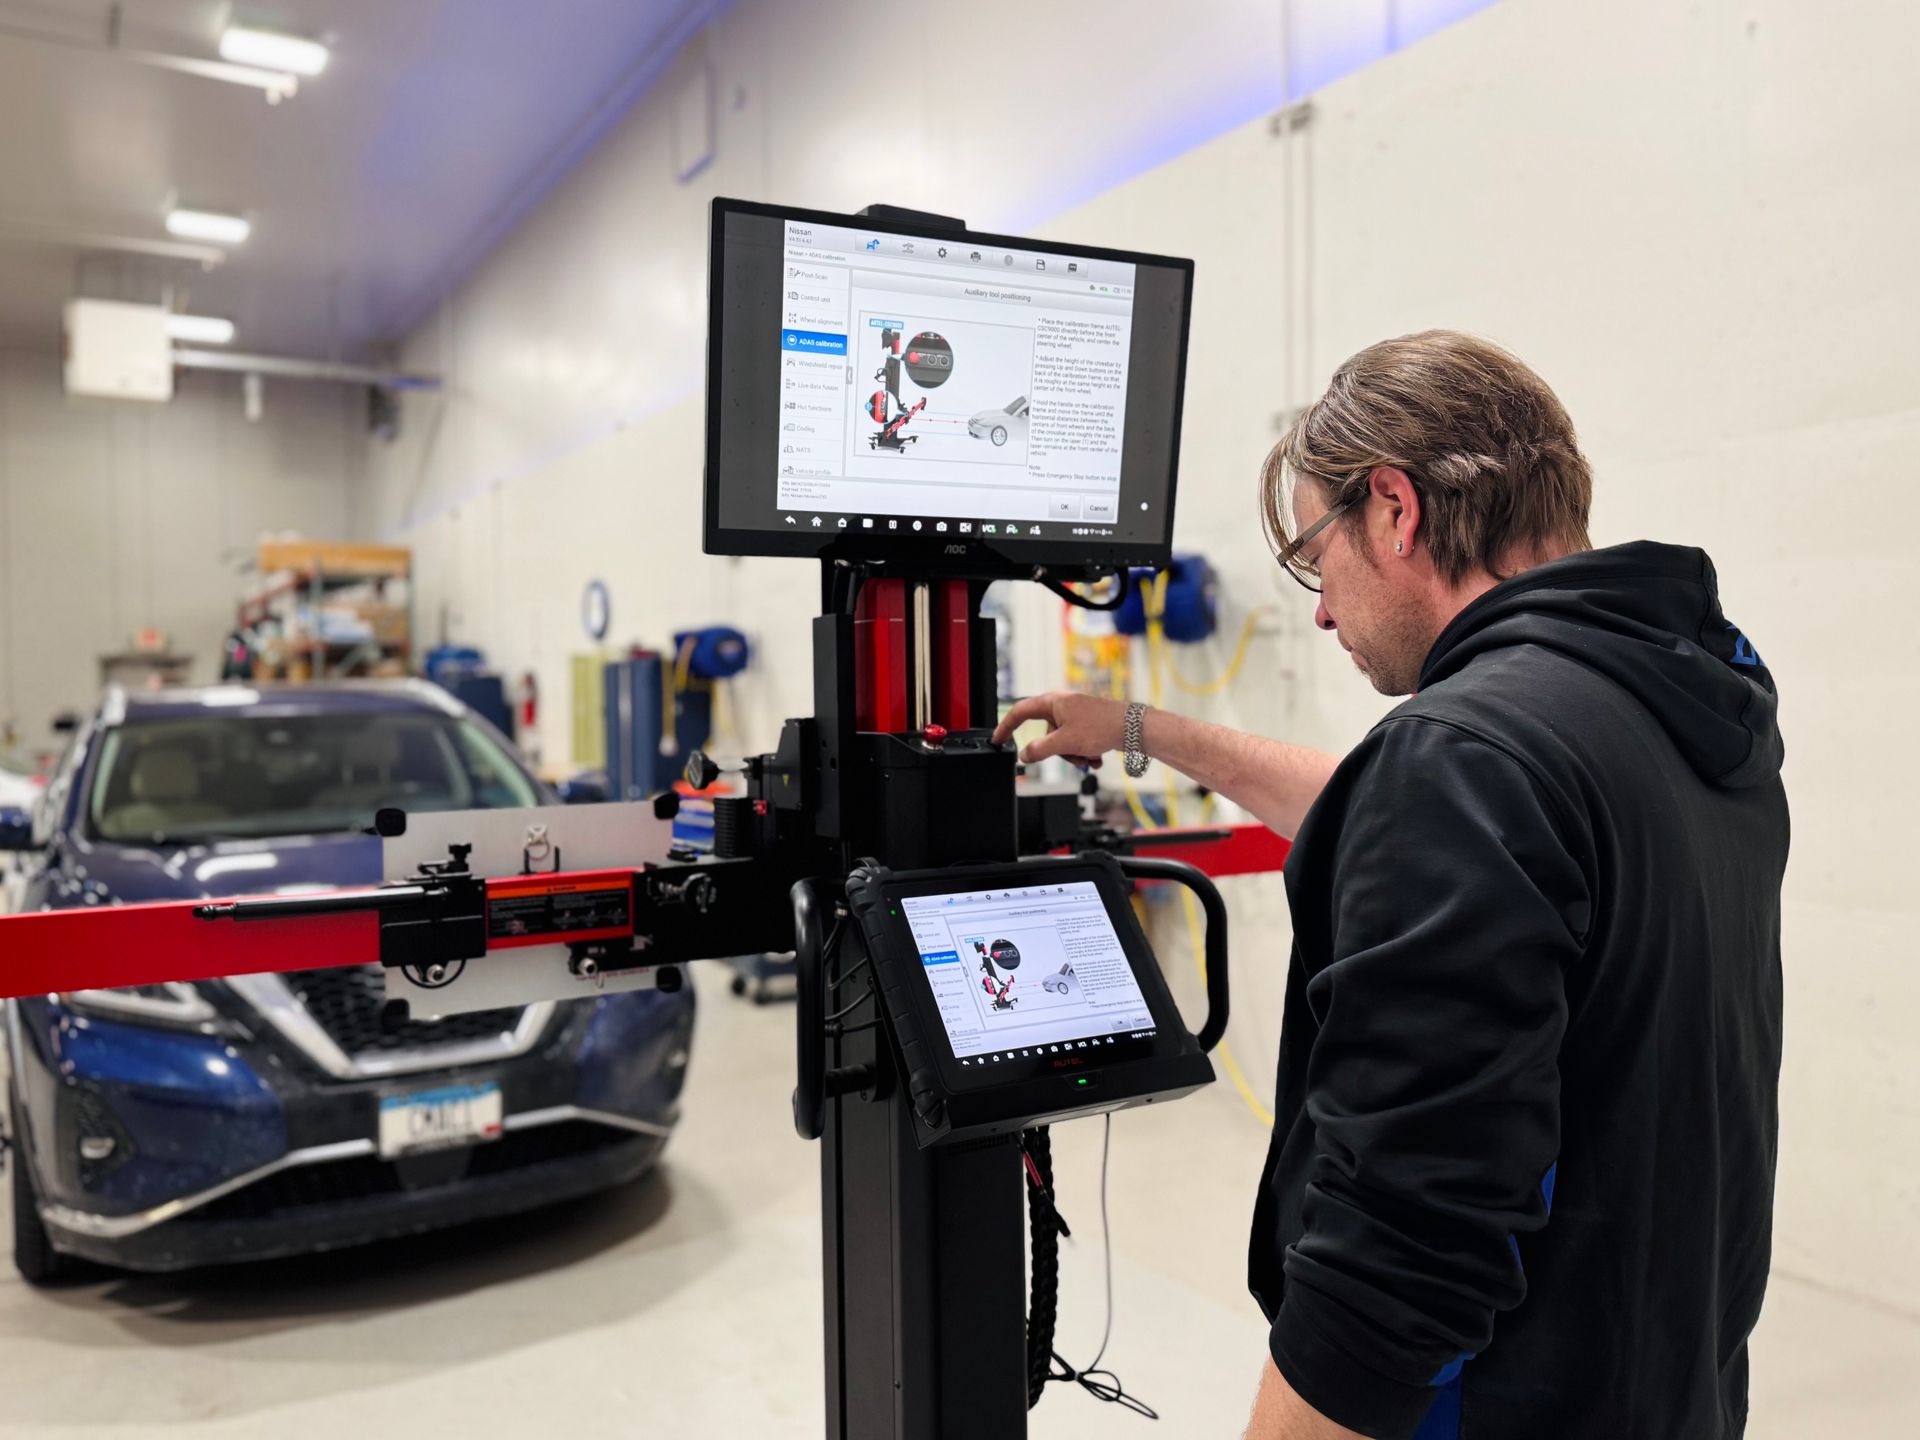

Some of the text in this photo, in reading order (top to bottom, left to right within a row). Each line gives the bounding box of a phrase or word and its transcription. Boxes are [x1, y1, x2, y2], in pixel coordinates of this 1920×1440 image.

[789, 227, 812, 236] Nissan
[801, 294, 819, 302] Control
[964, 288, 988, 298] Auxiliary
[1001, 293, 1031, 303] positioning
[800, 316, 843, 327] Wheel alignment
[1037, 325, 1060, 333] CSC9000
[1061, 328, 1078, 336] directly
[799, 338, 843, 348] ADAS calibration
[1064, 357, 1079, 365] height
[1035, 363, 1056, 371] pressing
[808, 404, 832, 412] functions
[797, 425, 815, 433] Coding
[944, 544, 966, 554] AOC
